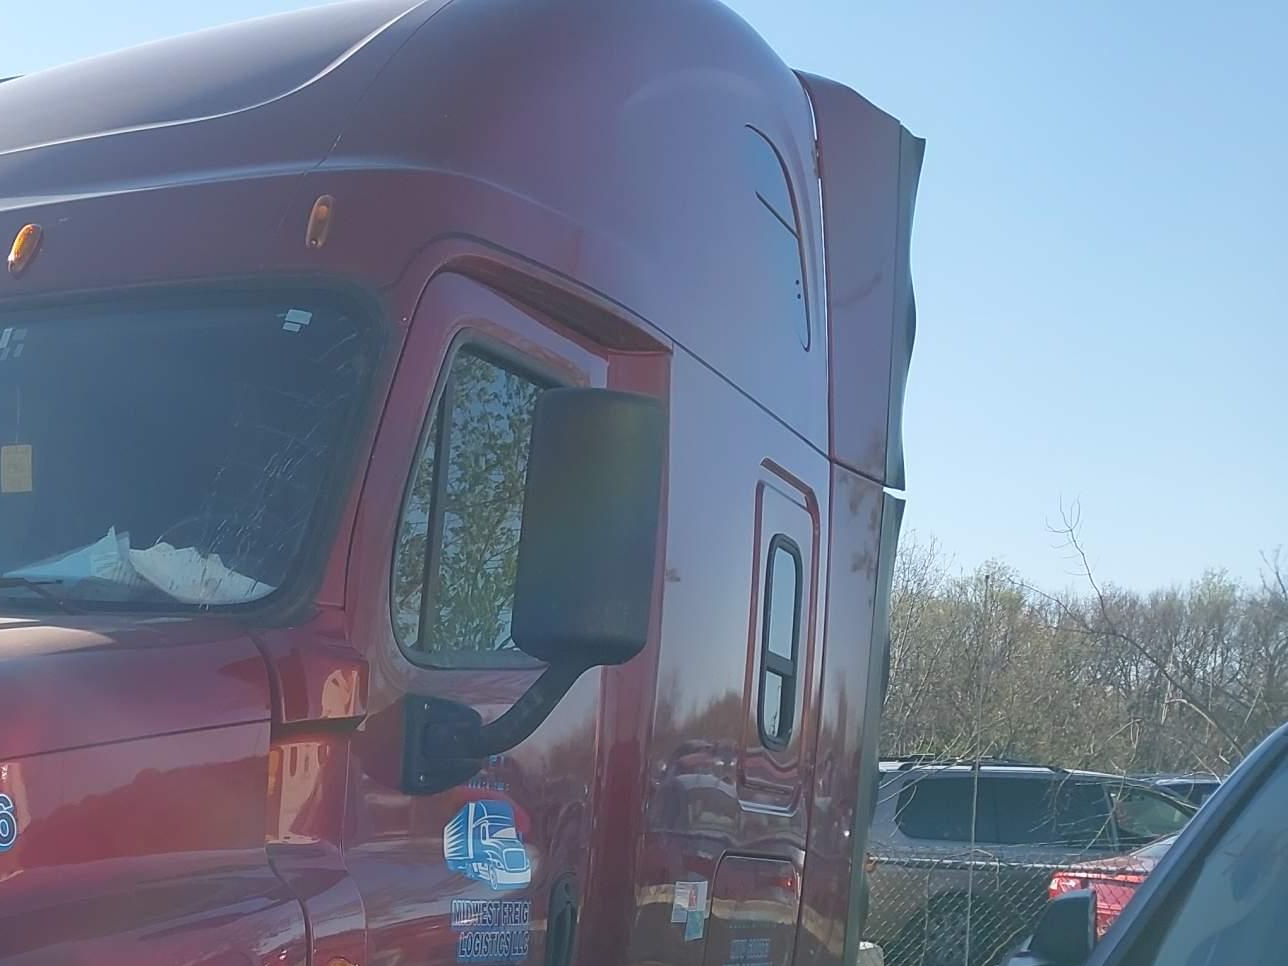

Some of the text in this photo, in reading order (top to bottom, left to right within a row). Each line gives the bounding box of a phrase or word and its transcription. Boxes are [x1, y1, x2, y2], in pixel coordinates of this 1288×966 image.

[452, 899, 501, 926] MIDWEST
[459, 930, 529, 957] LOGISTICS LLC
